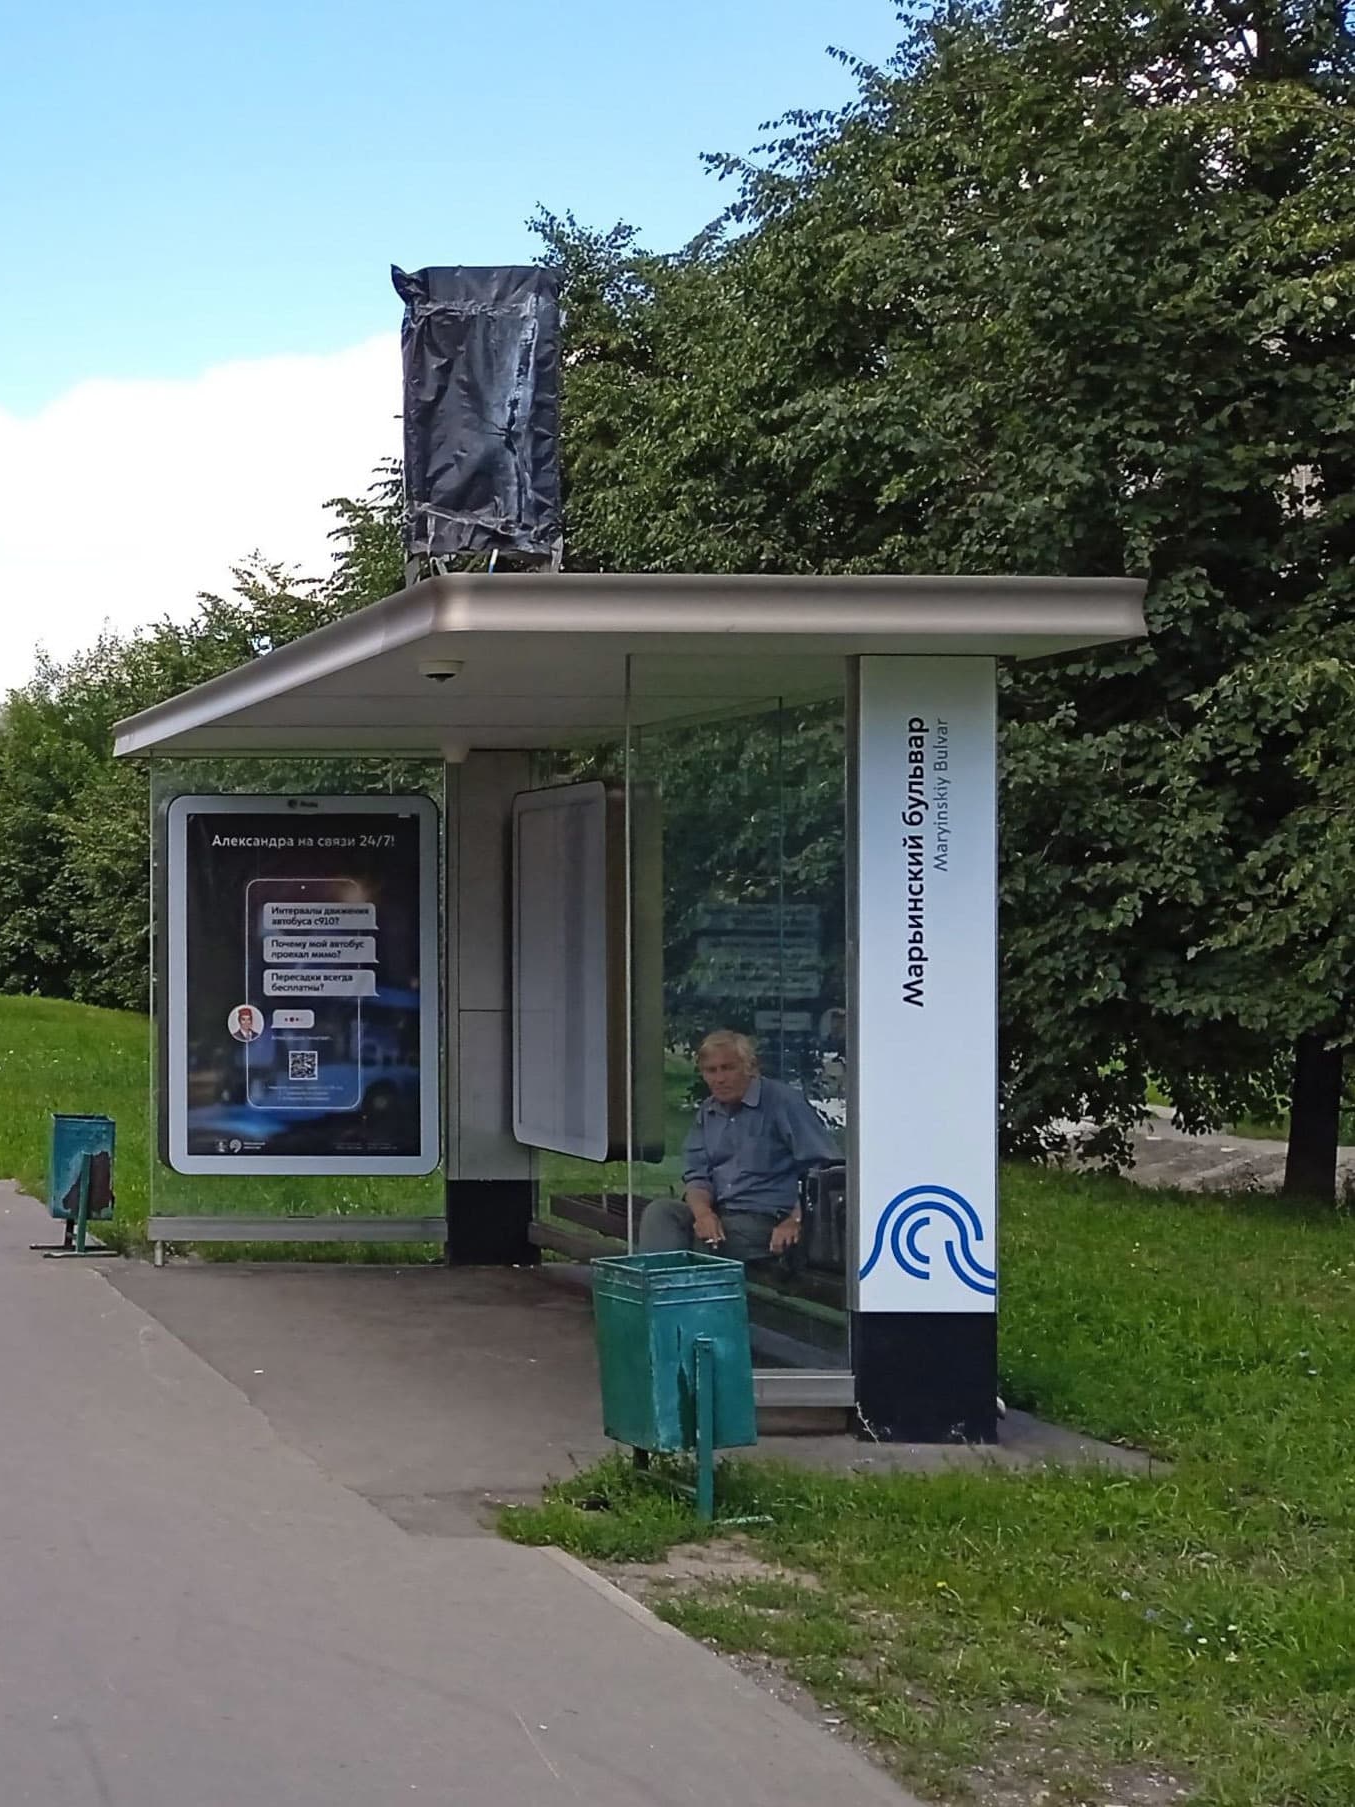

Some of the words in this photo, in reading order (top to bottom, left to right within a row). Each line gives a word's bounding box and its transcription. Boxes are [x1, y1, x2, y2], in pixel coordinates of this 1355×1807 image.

[933, 718, 949, 772] Bulvar
[902, 716, 929, 826] бульвар
[933, 776, 951, 872] Maryinskiy
[211, 834, 294, 849] Александра
[297, 838, 314, 848] на
[317, 838, 356, 848] связи
[359, 834, 396, 849] 24/7!
[271, 906, 322, 916] Интервалы
[271, 917, 312, 927] автобуса
[902, 834, 928, 1008] Марьинский
[271, 939, 307, 950] Почему
[308, 939, 327, 948] мой
[329, 939, 365, 950] автобус
[271, 951, 309, 960] проехал
[311, 950, 342, 959] мимо?
[271, 972, 322, 982] Пересадки
[323, 974, 353, 982] всегда
[271, 983, 324, 992] бесплатны?
